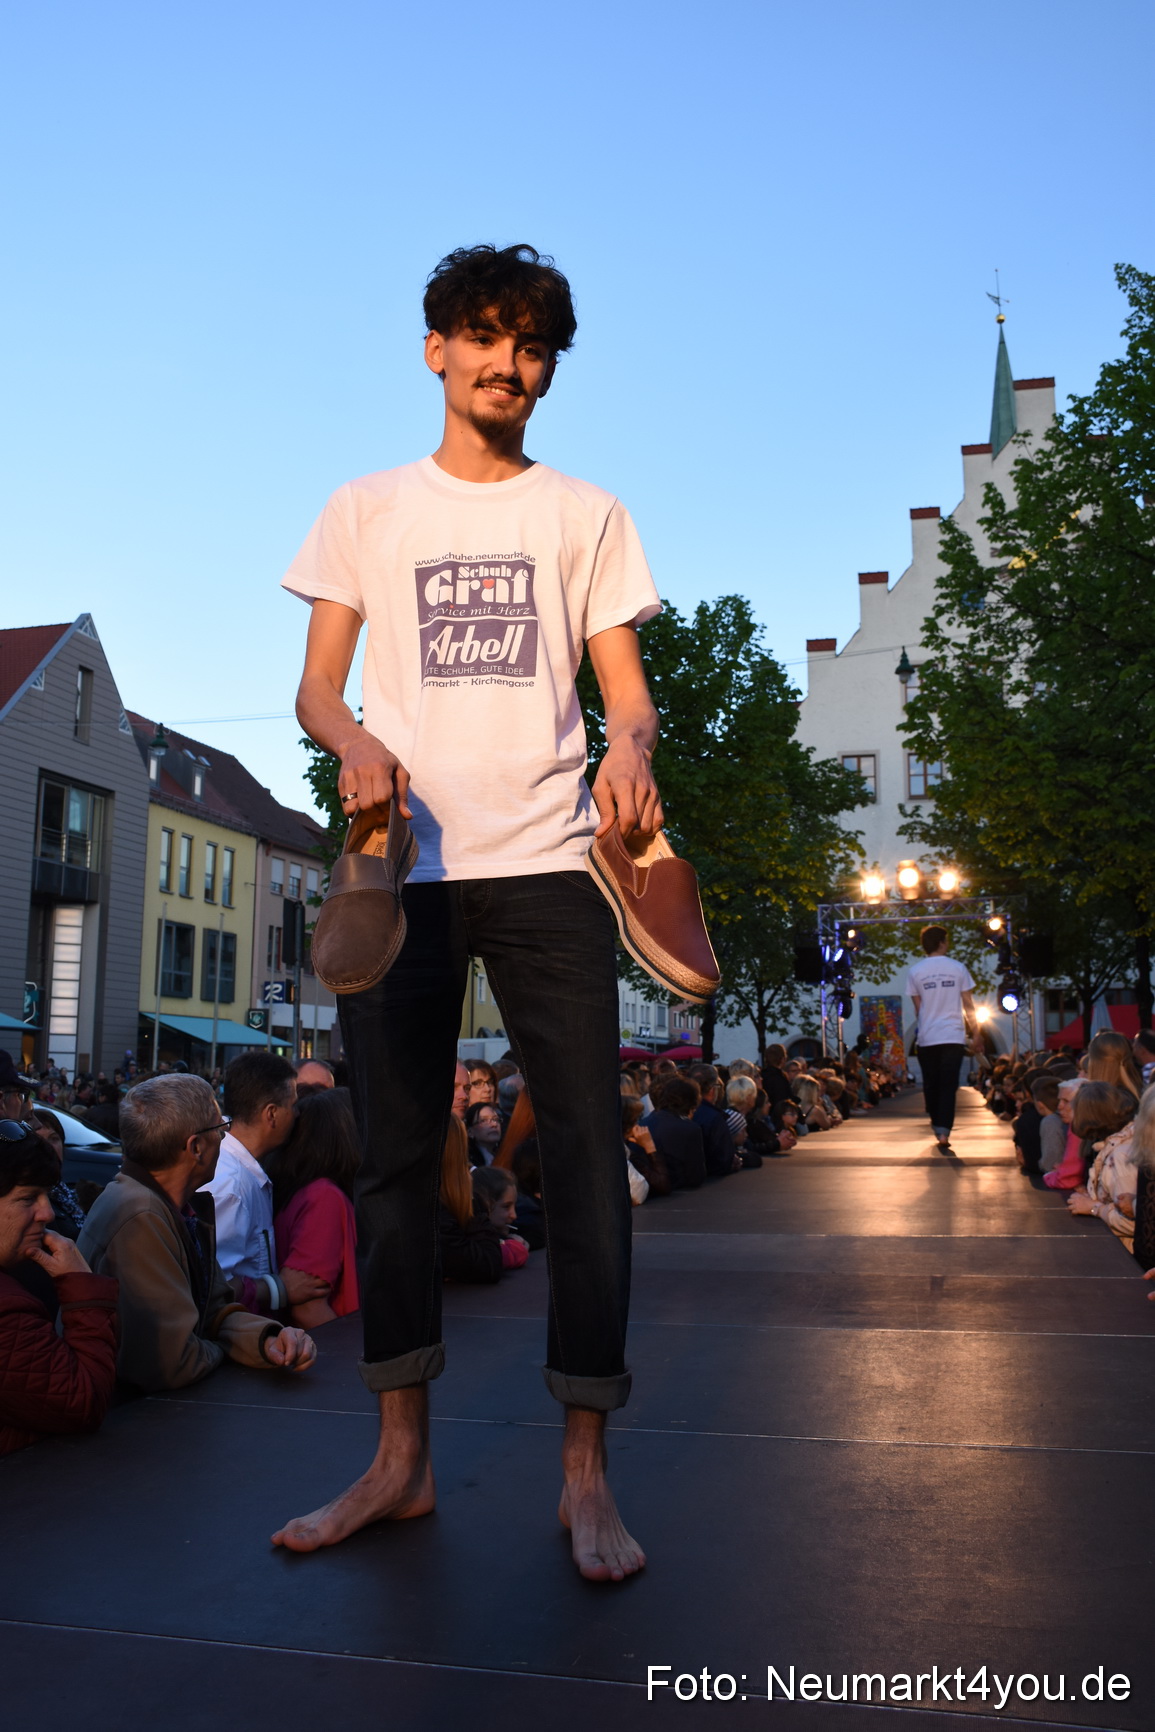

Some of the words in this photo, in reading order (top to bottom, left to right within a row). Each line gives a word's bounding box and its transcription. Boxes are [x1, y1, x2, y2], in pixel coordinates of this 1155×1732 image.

[458, 565, 511, 578] Schuh
[428, 605, 465, 621] Service
[470, 605, 492, 615] mit
[496, 606, 530, 616] Herz
[425, 624, 525, 665] Arbell
[424, 666, 439, 676] UTE
[441, 666, 478, 676] SCHUHE,
[480, 665, 503, 674] GUTE
[505, 666, 524, 676] IDEE
[423, 679, 460, 688] umarkt
[471, 676, 535, 688] Kirchengasse
